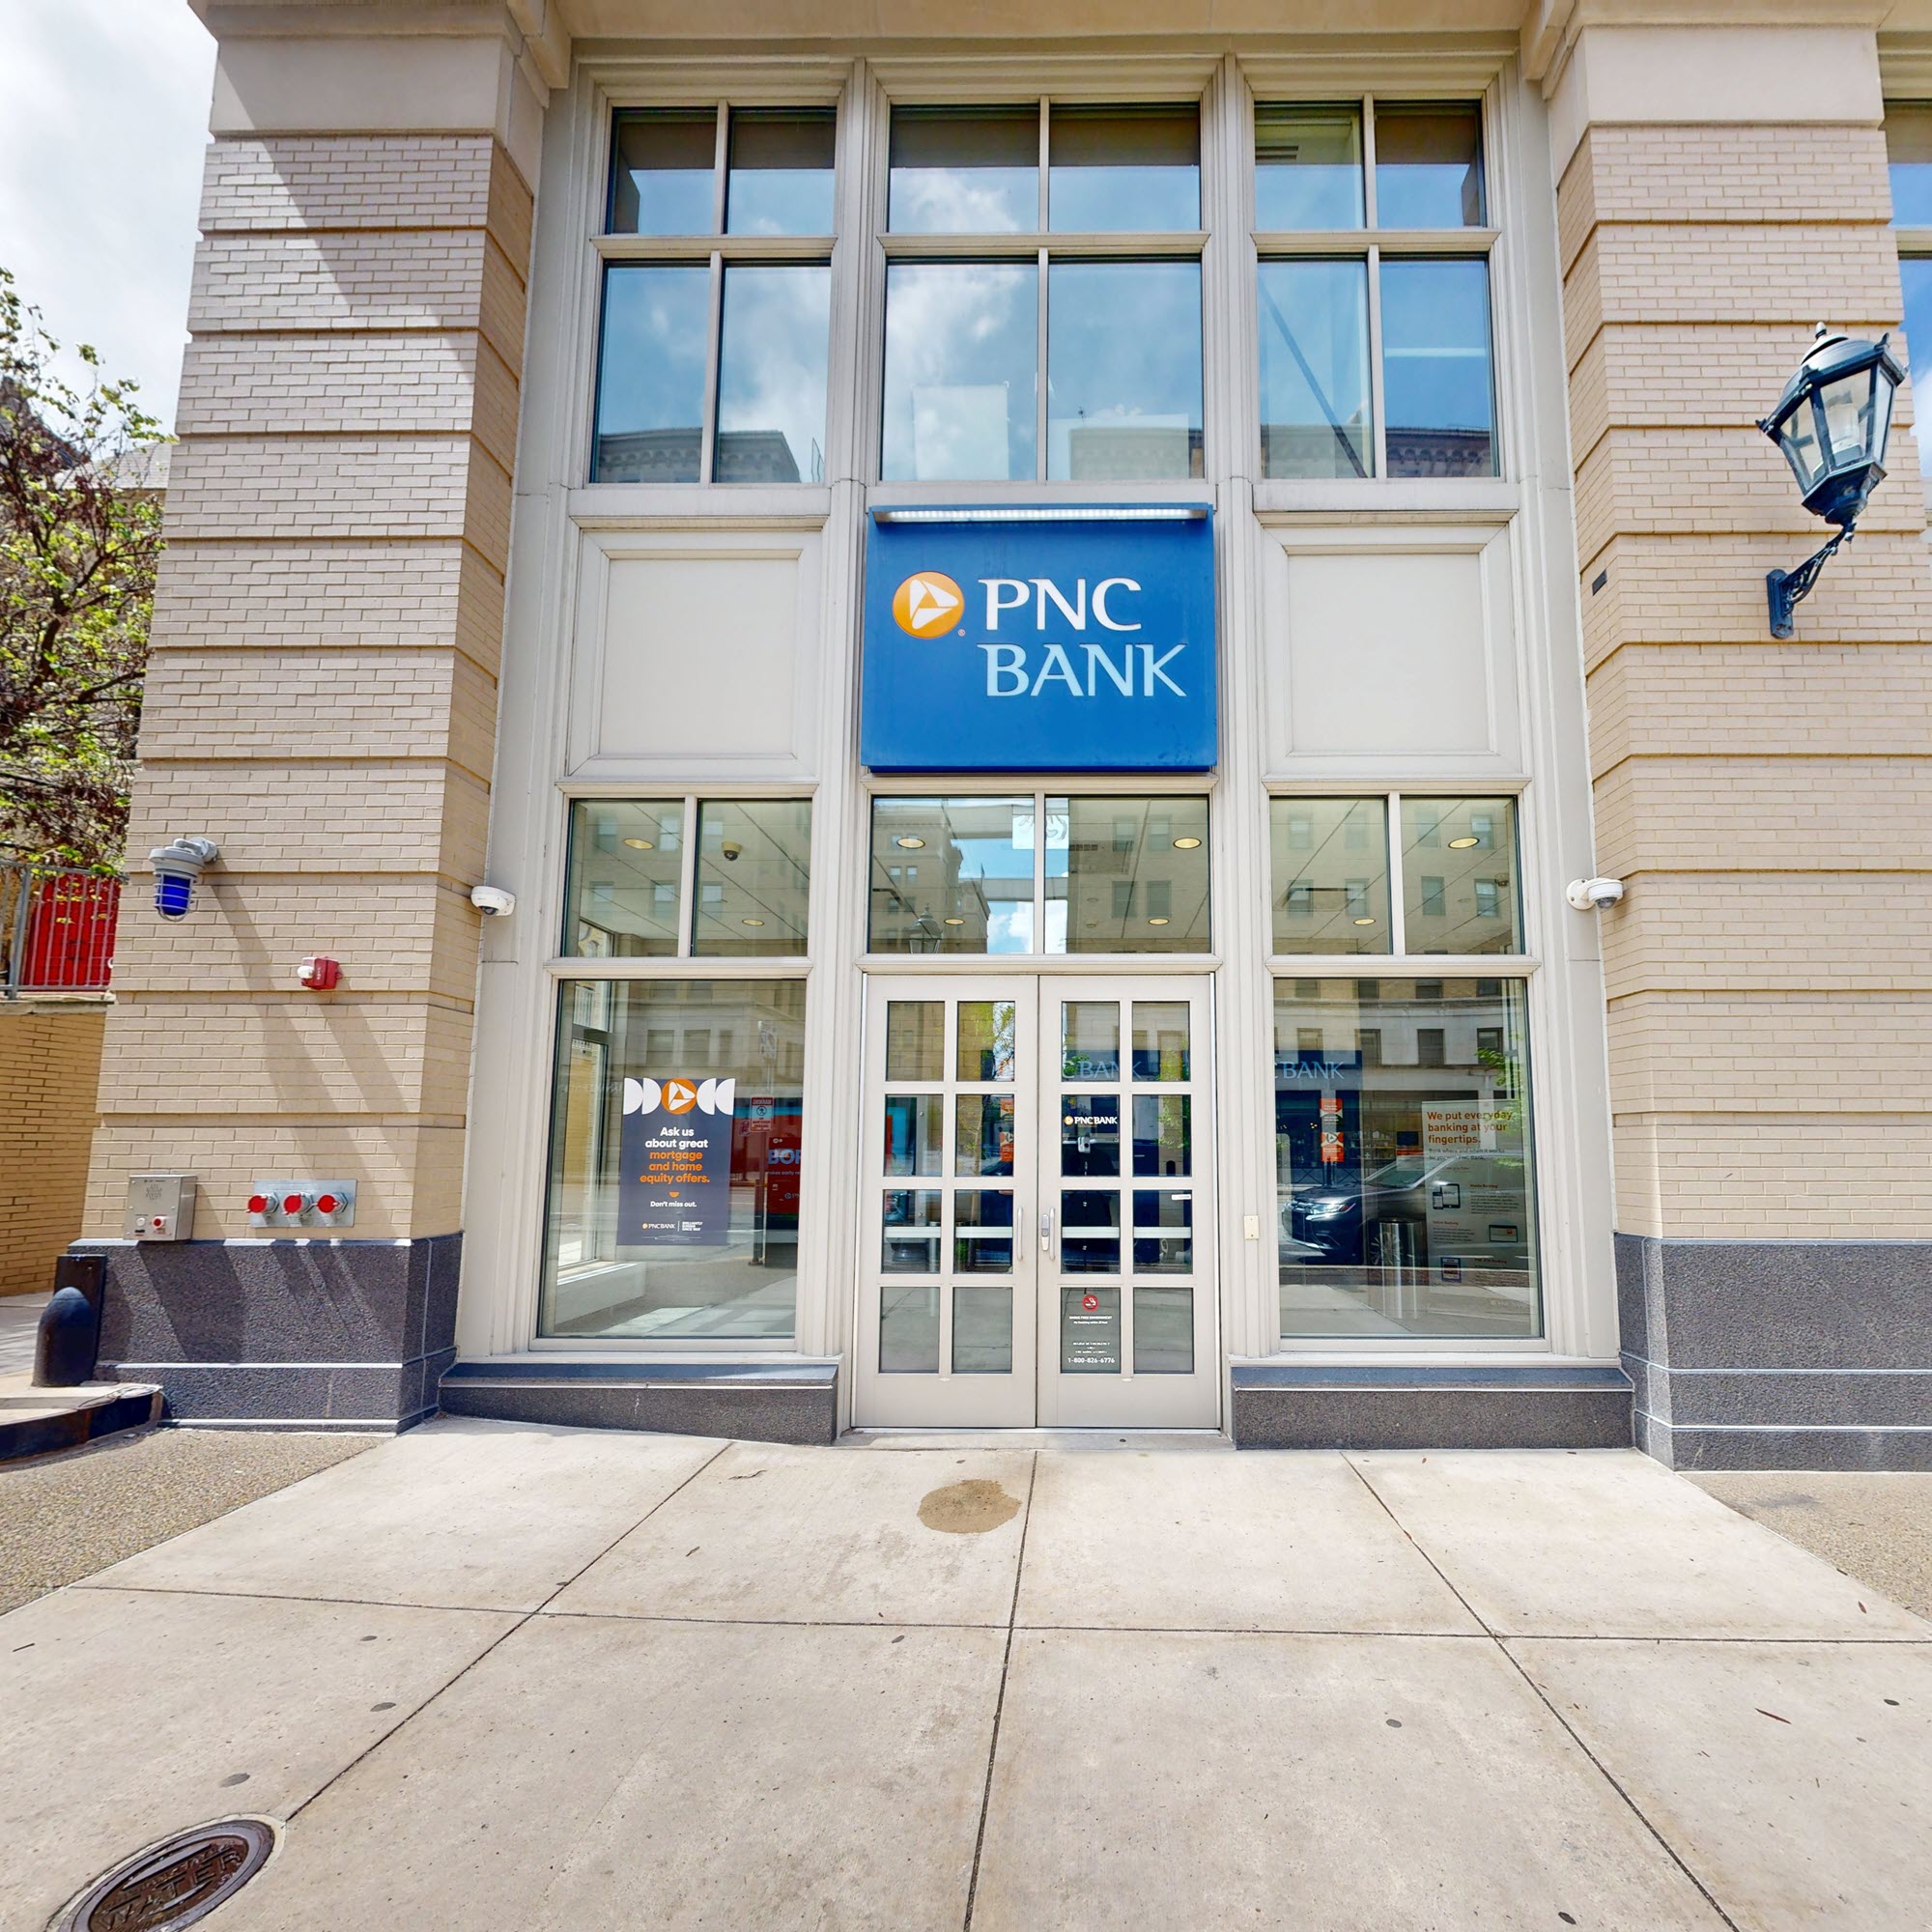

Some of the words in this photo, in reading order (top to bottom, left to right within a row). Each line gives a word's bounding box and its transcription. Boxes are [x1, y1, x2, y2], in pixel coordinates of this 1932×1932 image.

[978, 578, 1142, 631] PNC
[977, 643, 1187, 696] BANK
[1280, 1061, 1345, 1079] BANK
[1427, 1112, 1442, 1121] We
[1445, 1112, 1463, 1121] put
[1464, 1110, 1513, 1122] everyday
[660, 1126, 680, 1137] Ask
[682, 1128, 695, 1137] us
[1428, 1122, 1468, 1132] banking
[1484, 1123, 1507, 1132] your
[644, 1138, 677, 1149] about
[678, 1139, 709, 1151] great
[1428, 1134, 1481, 1145] fingertips.
[649, 1151, 703, 1162] mortgage
[649, 1161, 670, 1171] and
[671, 1161, 703, 1171] home
[639, 1173, 674, 1184] equity
[675, 1173, 710, 1183] offers.
[98, 1850, 242, 1931] WATER
